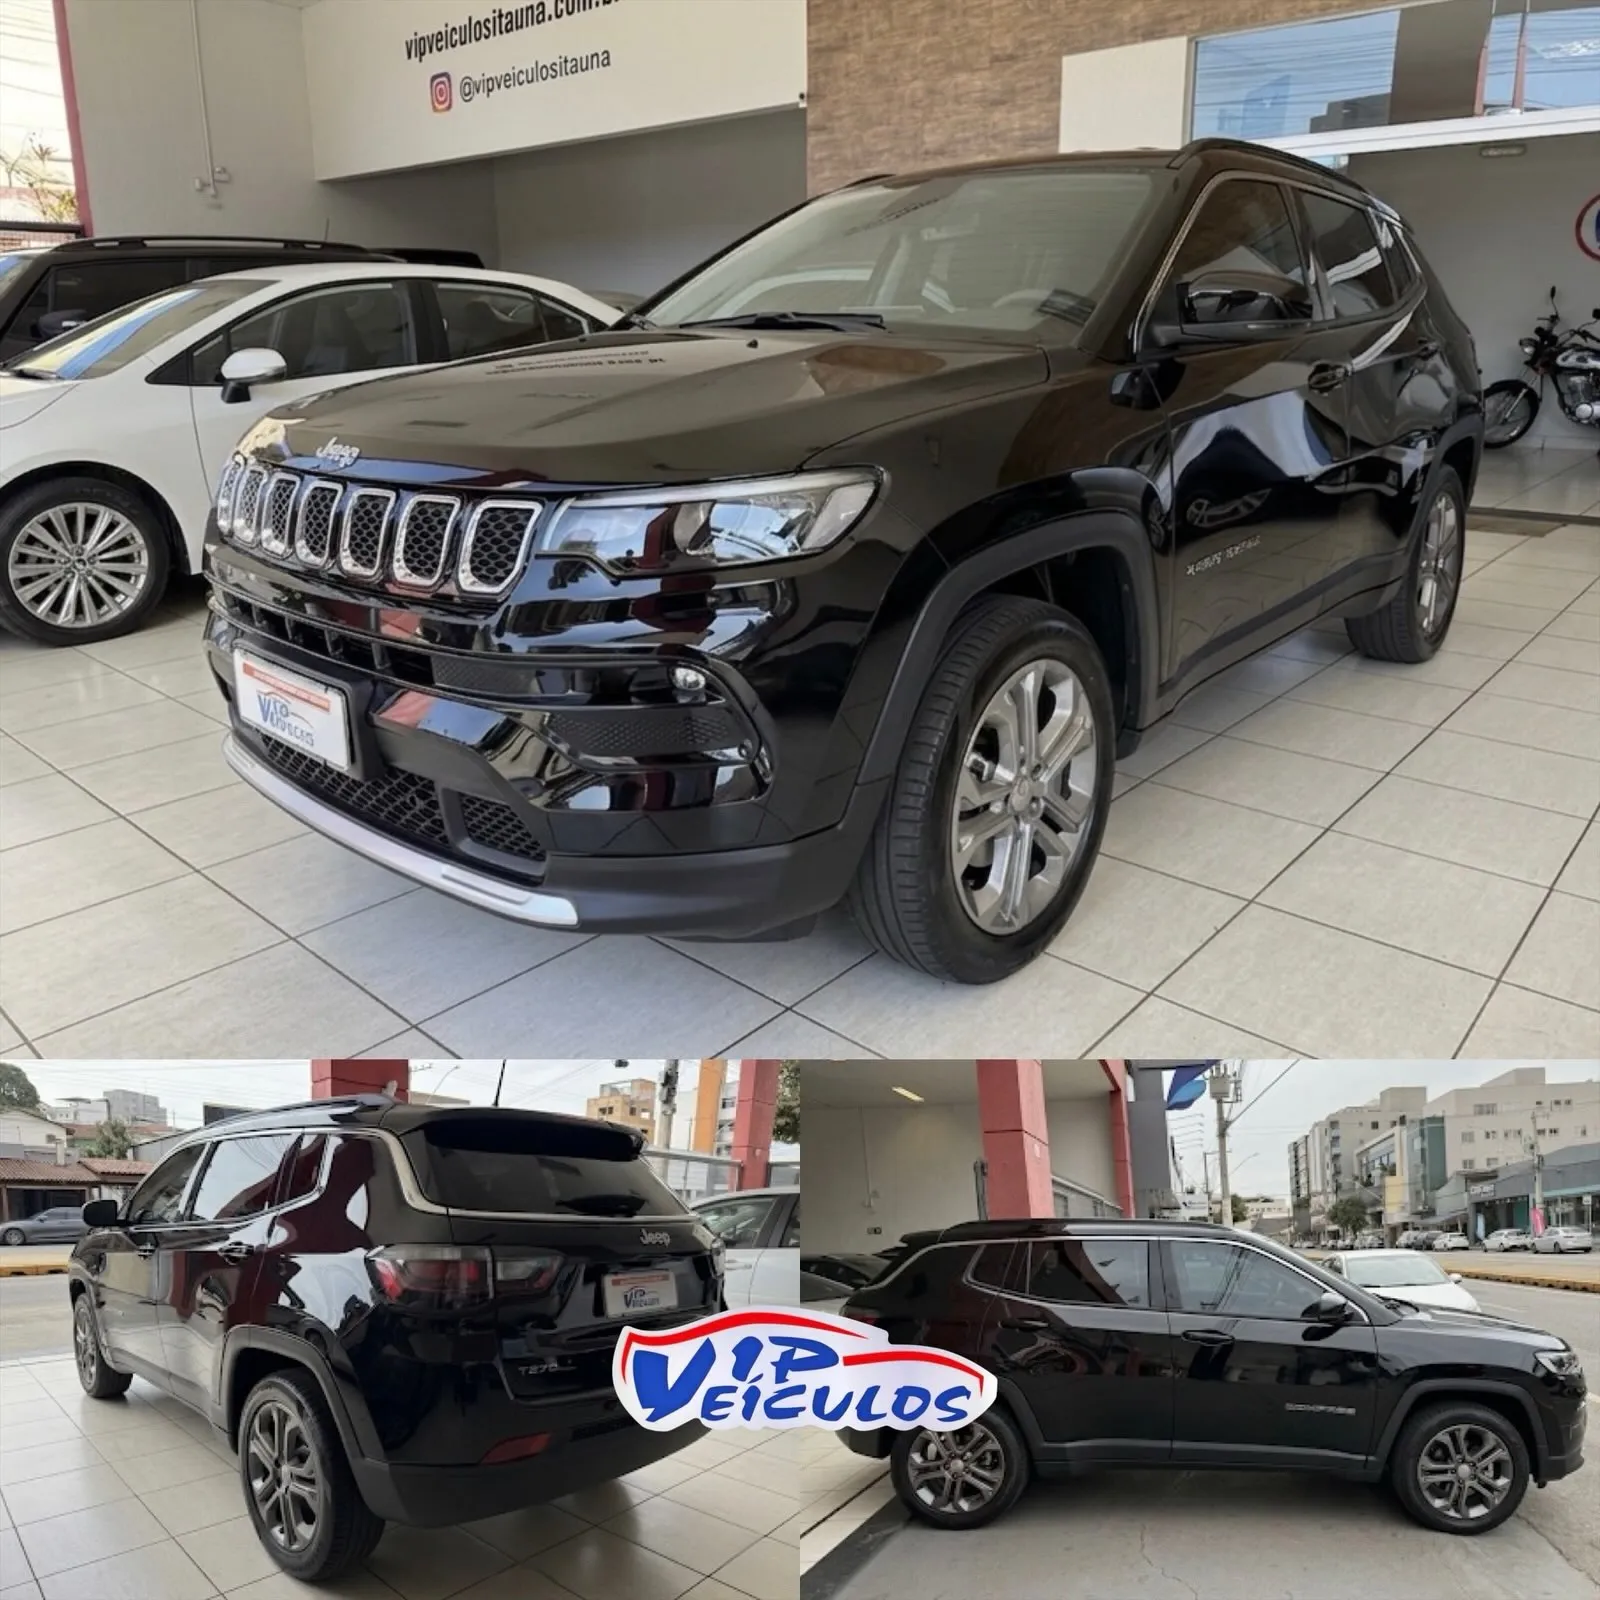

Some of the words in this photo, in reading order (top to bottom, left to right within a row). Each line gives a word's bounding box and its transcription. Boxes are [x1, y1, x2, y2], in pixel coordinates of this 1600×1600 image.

[404, 0, 620, 63] vipveiculositauna.com.
[459, 48, 611, 103] @vipveiculositauna
[640, 1227, 671, 1248] Jeep
